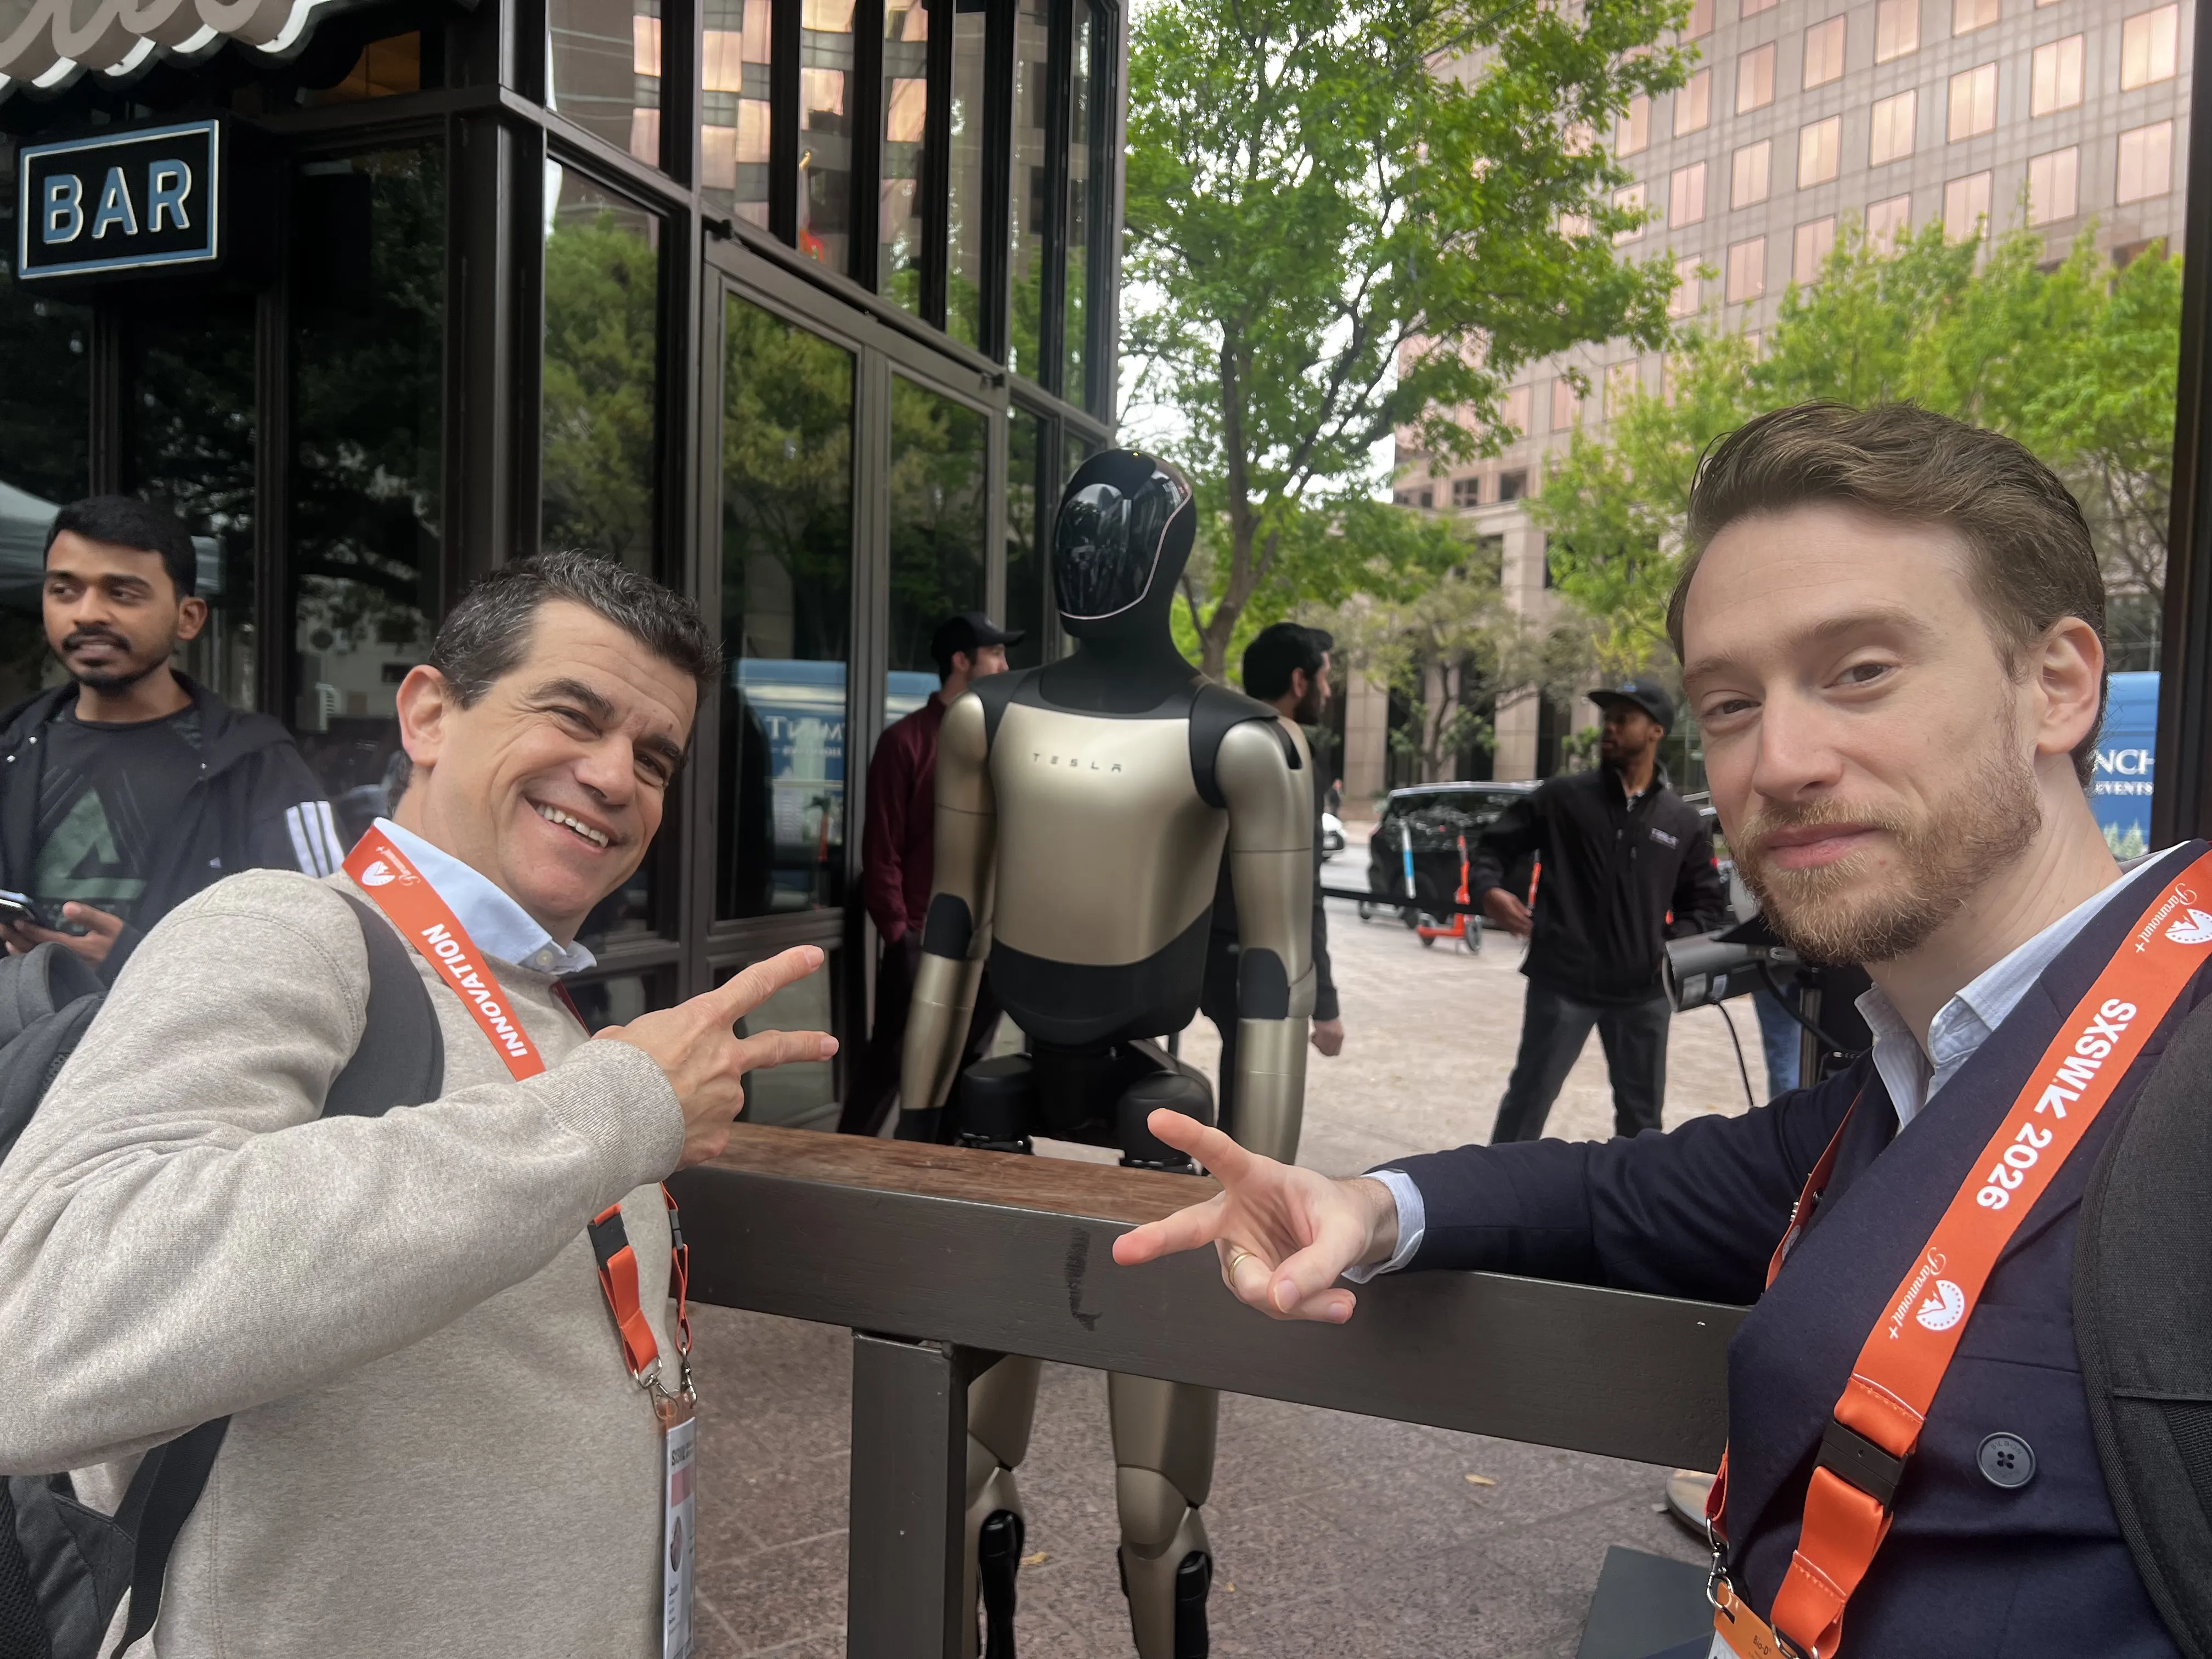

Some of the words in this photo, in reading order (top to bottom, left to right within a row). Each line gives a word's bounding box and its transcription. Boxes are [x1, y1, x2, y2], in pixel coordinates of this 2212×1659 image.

[43, 158, 192, 245] BAR
[1032, 752, 1122, 773] TESLA
[421, 923, 528, 1057] INNOVATION
[2055, 998, 2137, 1091] SXSW
[1976, 1121, 2053, 1210] 2026
